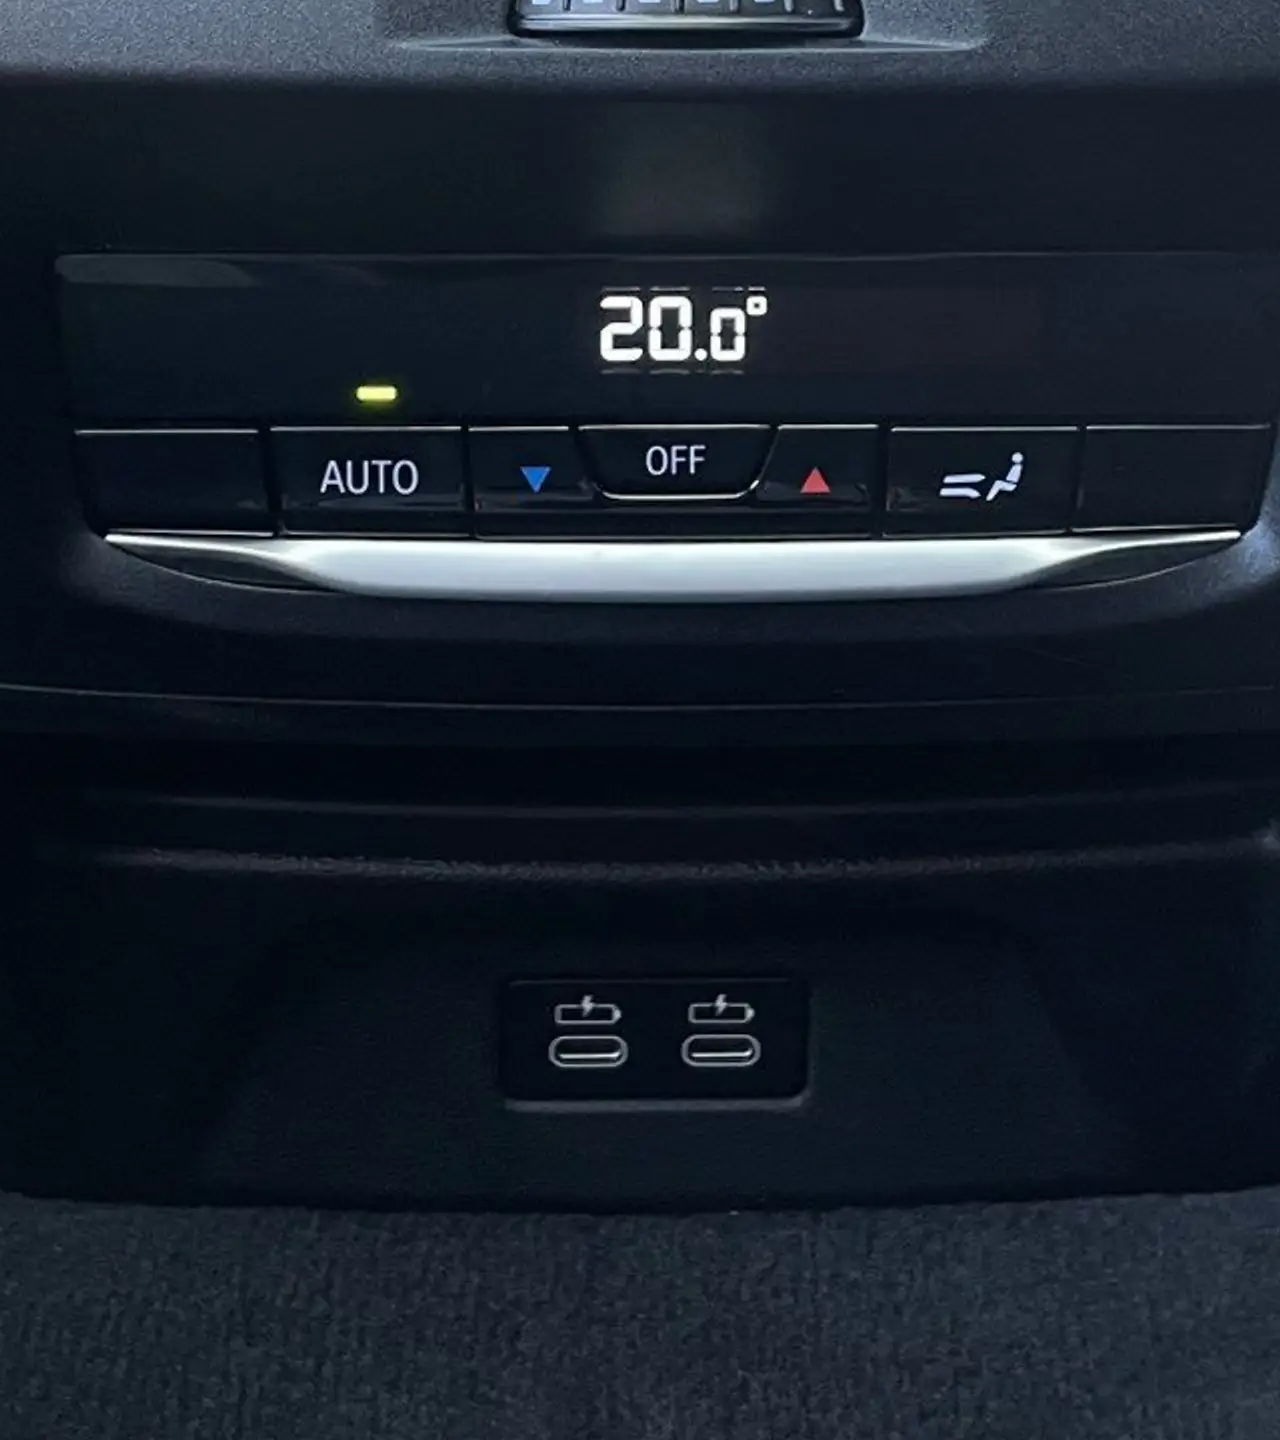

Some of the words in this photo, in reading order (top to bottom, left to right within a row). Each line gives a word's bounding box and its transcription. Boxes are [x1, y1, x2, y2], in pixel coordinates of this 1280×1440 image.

[599, 295, 768, 362] 20.0°
[319, 459, 419, 496] AUTO
[645, 444, 707, 476] OFF
